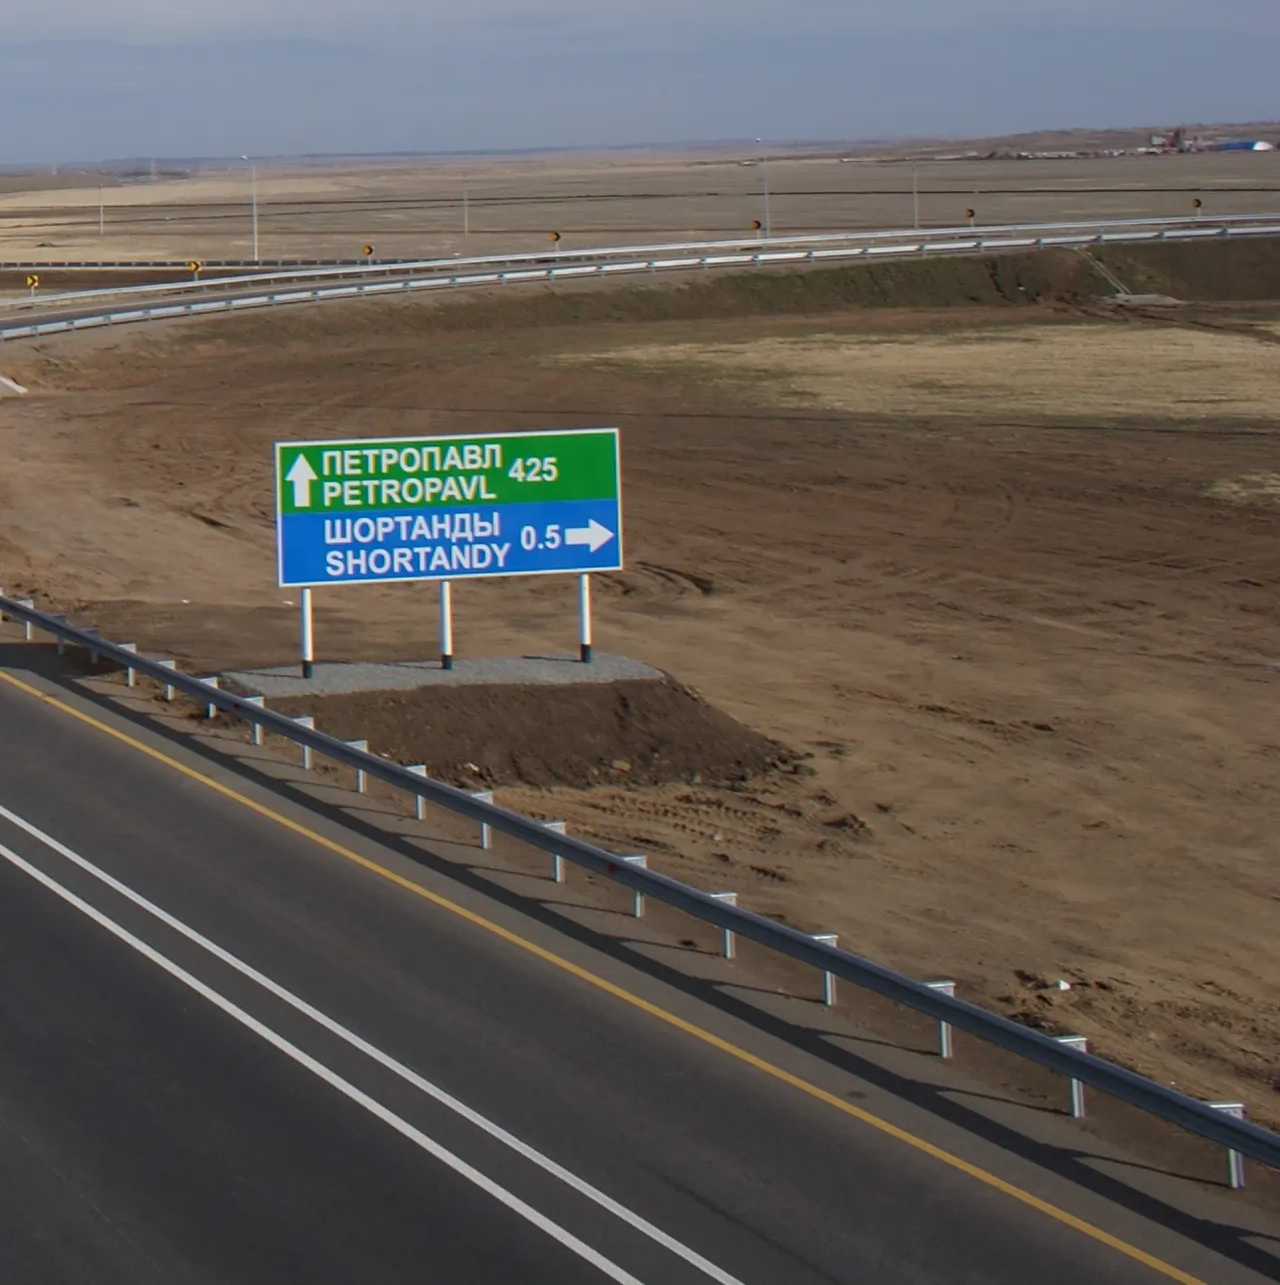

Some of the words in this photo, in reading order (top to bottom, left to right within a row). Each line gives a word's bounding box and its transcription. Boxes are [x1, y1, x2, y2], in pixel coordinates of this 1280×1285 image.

[322, 444, 502, 476] ПЕТРОПАВЛ
[507, 457, 558, 482] 425
[323, 475, 497, 507] PETROPAVL
[324, 512, 500, 544] ШОРТАНДЫ
[520, 525, 561, 550] 0.5
[325, 543, 511, 576] SHORTANDY
